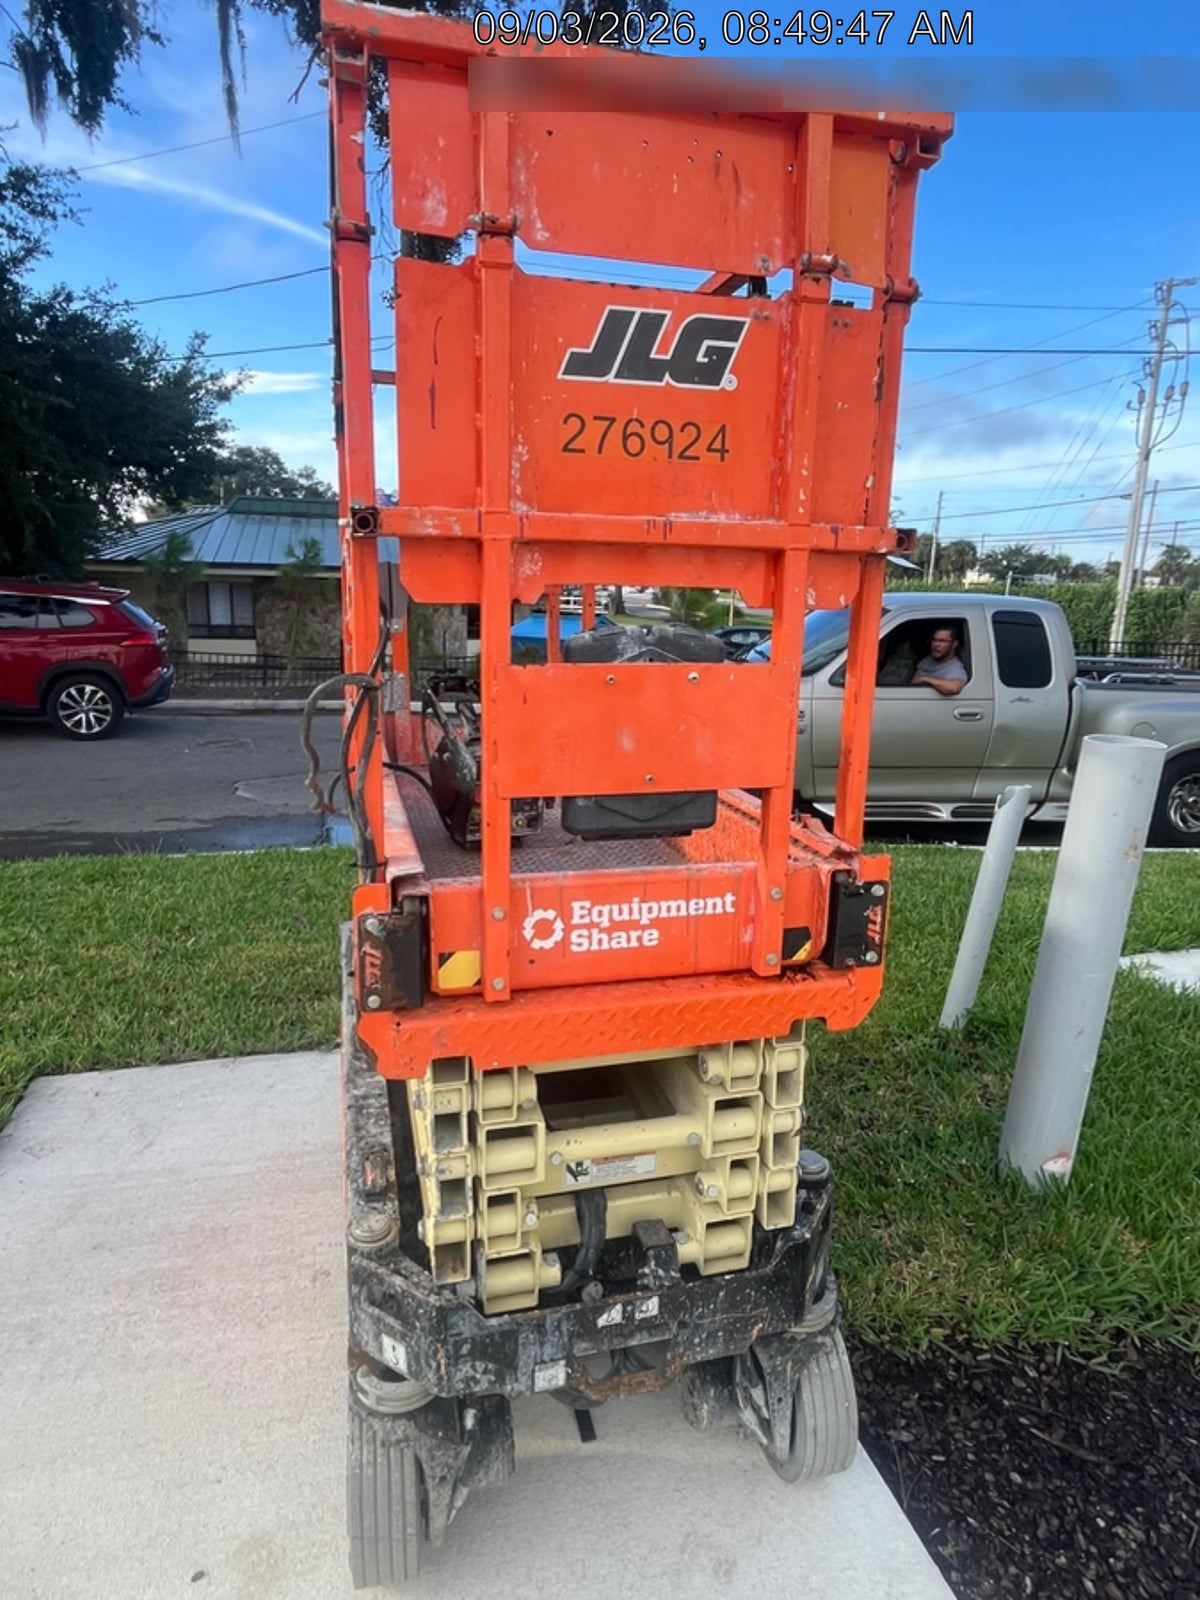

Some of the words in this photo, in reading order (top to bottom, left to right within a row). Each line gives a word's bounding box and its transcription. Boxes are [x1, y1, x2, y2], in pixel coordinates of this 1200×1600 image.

[561, 412, 730, 463] 276924
[570, 892, 736, 928] Equipment
[570, 928, 659, 952] Share
